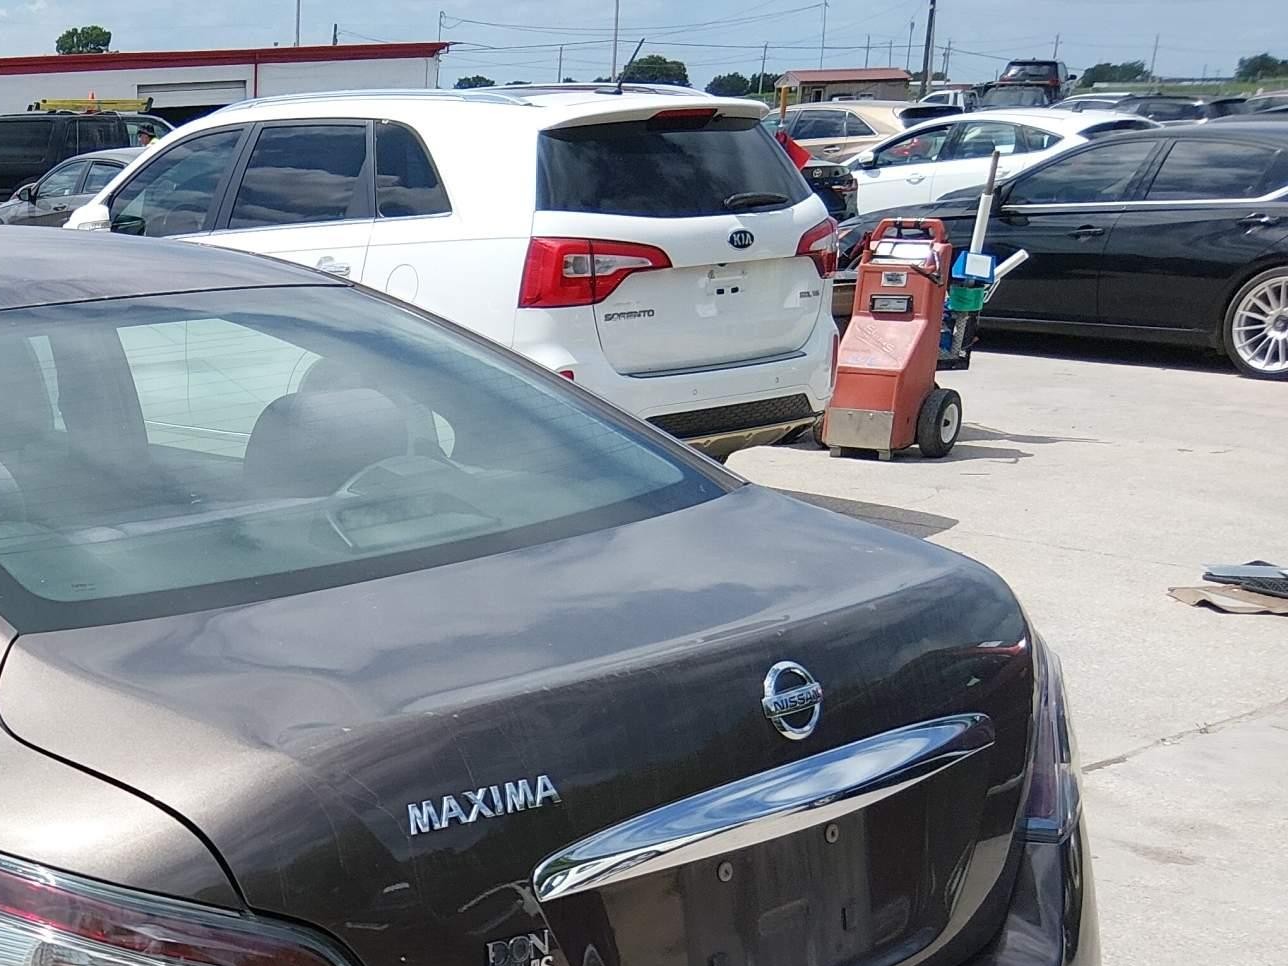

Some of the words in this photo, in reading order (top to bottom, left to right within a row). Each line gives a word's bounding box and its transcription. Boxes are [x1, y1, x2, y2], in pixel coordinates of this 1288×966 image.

[733, 232, 753, 247] KIA
[773, 687, 821, 711] NISSAN
[407, 774, 562, 836] MAXIMA
